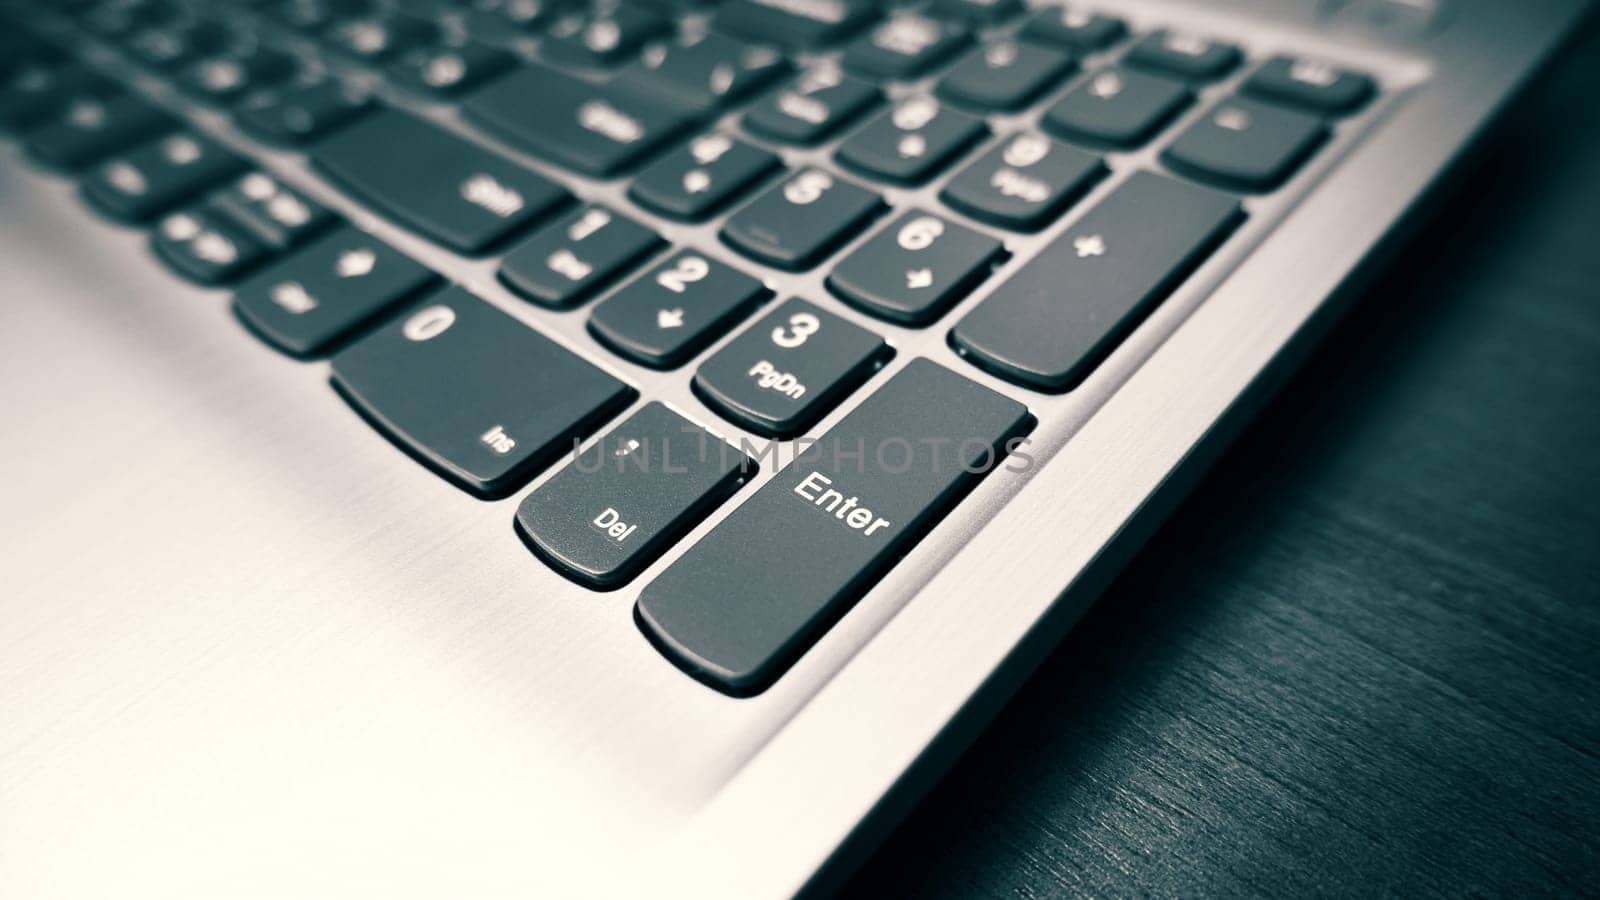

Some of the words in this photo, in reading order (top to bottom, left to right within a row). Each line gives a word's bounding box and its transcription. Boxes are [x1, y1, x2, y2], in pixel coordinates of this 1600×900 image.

[786, 169, 835, 203] 5
[570, 208, 611, 240] 1
[897, 216, 945, 250] 6
[658, 257, 711, 292] 2
[404, 306, 455, 341] 0
[772, 313, 820, 347] 3
[749, 360, 806, 400] PgDn
[481, 425, 517, 454] Ins
[793, 470, 890, 536] Enter
[593, 507, 637, 542] Del
